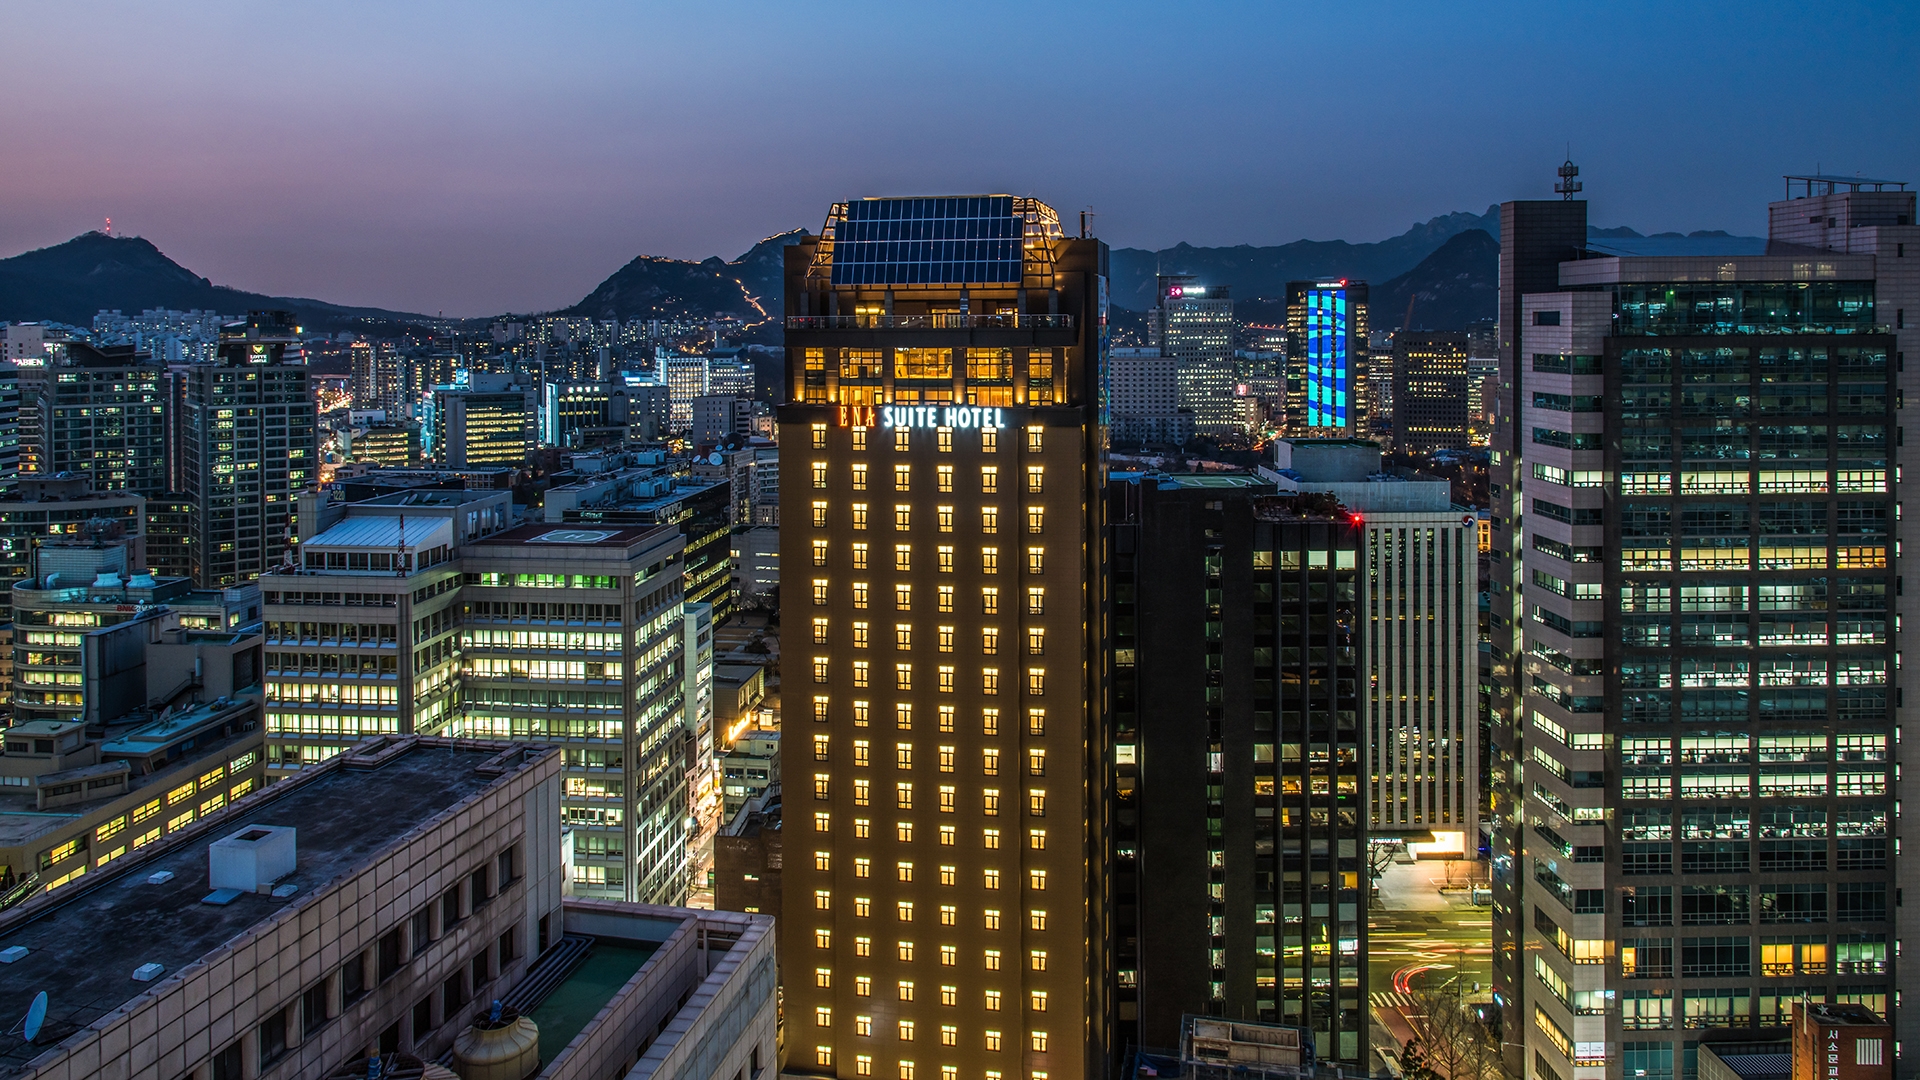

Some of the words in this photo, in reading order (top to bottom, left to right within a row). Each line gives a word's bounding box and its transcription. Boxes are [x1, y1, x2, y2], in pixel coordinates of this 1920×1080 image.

[840, 406, 875, 427] ENA
[884, 407, 937, 428] SUITE
[945, 407, 1005, 428] HOTEL
[1827, 1029, 1839, 1080] 서소문교
